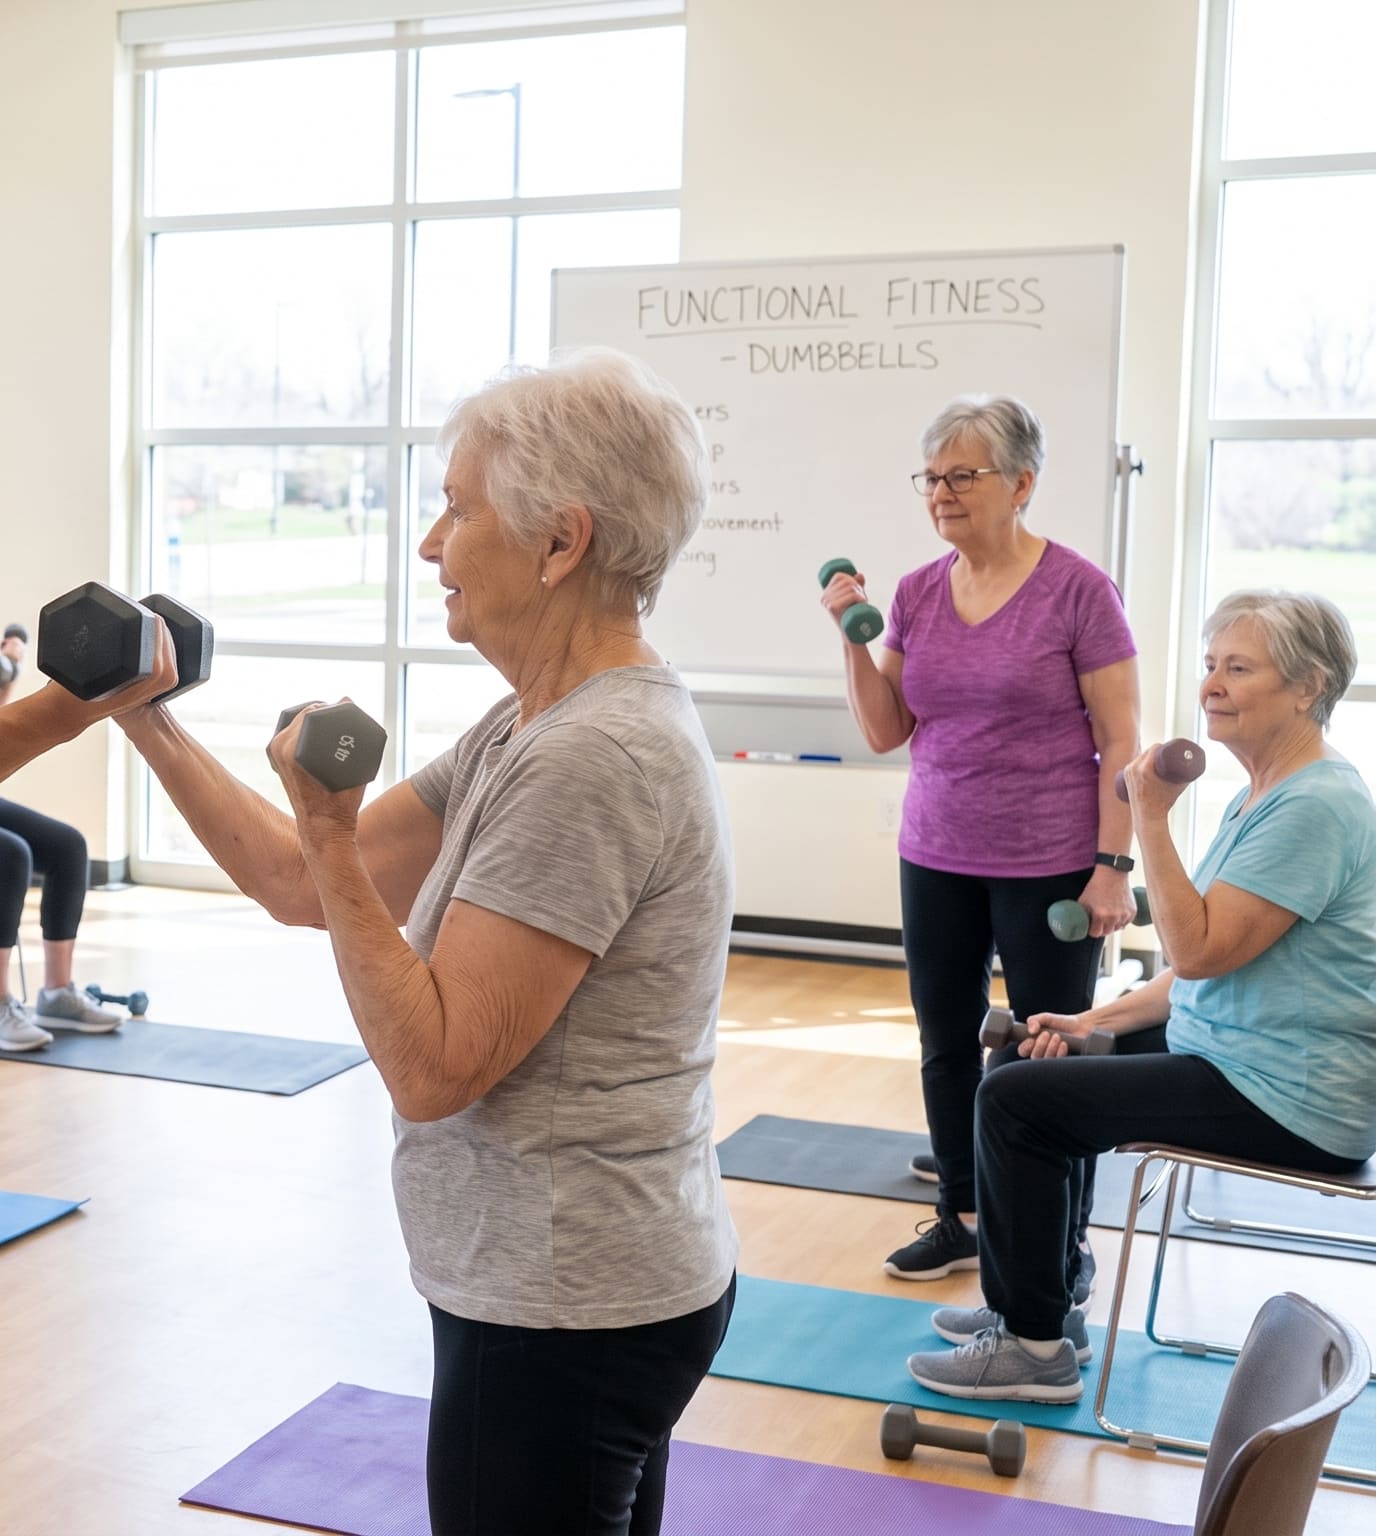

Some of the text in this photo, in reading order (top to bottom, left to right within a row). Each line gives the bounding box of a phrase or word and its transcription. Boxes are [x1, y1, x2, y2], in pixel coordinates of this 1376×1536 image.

[638, 277, 1045, 329] FUNCTIONAL FITNESS
[748, 340, 939, 374] DUMBBELLS
[695, 404, 730, 422] ers
[701, 511, 784, 532] ovement
